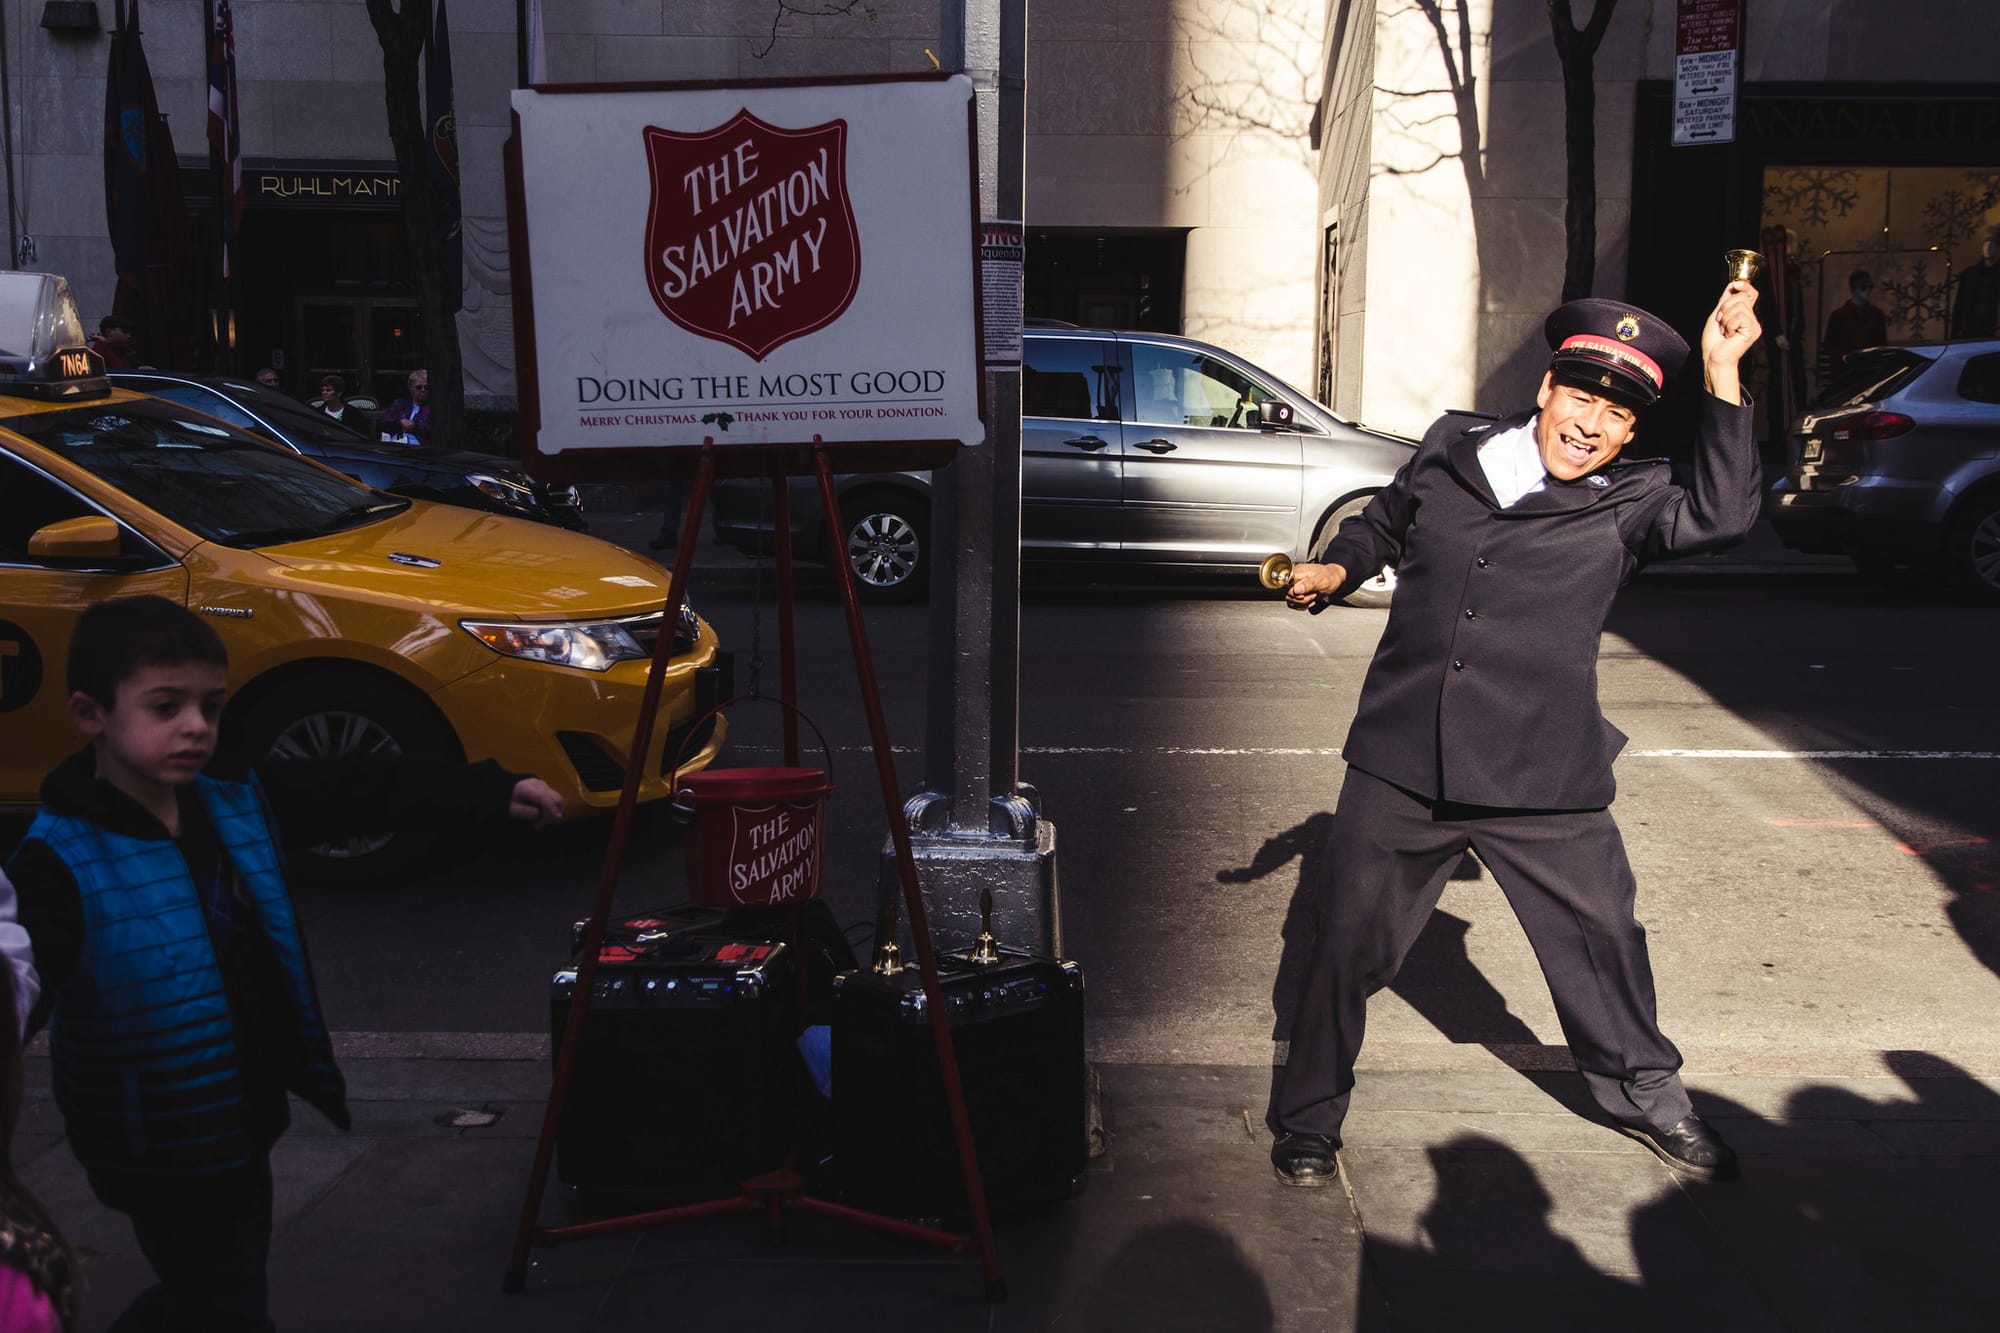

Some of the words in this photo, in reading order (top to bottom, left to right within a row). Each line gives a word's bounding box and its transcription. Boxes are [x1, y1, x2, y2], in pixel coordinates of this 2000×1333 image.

[1680, 20, 1707, 29] METERED
[1708, 17, 1734, 26] PARKING
[1711, 34, 1728, 42] 6PM
[1679, 71, 1705, 81] METERED
[1707, 68, 1733, 78] PARKING
[1682, 65, 1699, 73] MON
[1717, 61, 1730, 69] FRI
[1691, 79, 1708, 87] HOUR
[1676, 115, 1704, 124] METERED
[1705, 112, 1731, 121] PARKING
[1684, 107, 1724, 116] SATURDAY
[1708, 120, 1724, 129] LIMIT
[684, 138, 760, 216] THE
[662, 147, 830, 298] SALVATION
[727, 216, 828, 329] ARMY
[1586, 342, 1642, 367] SALVATION
[60, 352, 90, 378] 7N64
[577, 376, 684, 403] DOING
[690, 375, 749, 400] THE
[759, 373, 842, 398] MOST
[580, 415, 621, 428] MERRY
[625, 413, 700, 427] CHRISTMAS.
[735, 410, 780, 423] THANK
[781, 410, 809, 421] YOU
[812, 409, 836, 420] FOR
[839, 408, 873, 420] YOUR
[877, 406, 948, 419] DONATION.
[749, 811, 790, 850] THE
[734, 815, 816, 890] SALVATION
[769, 848, 815, 905] ARMY
